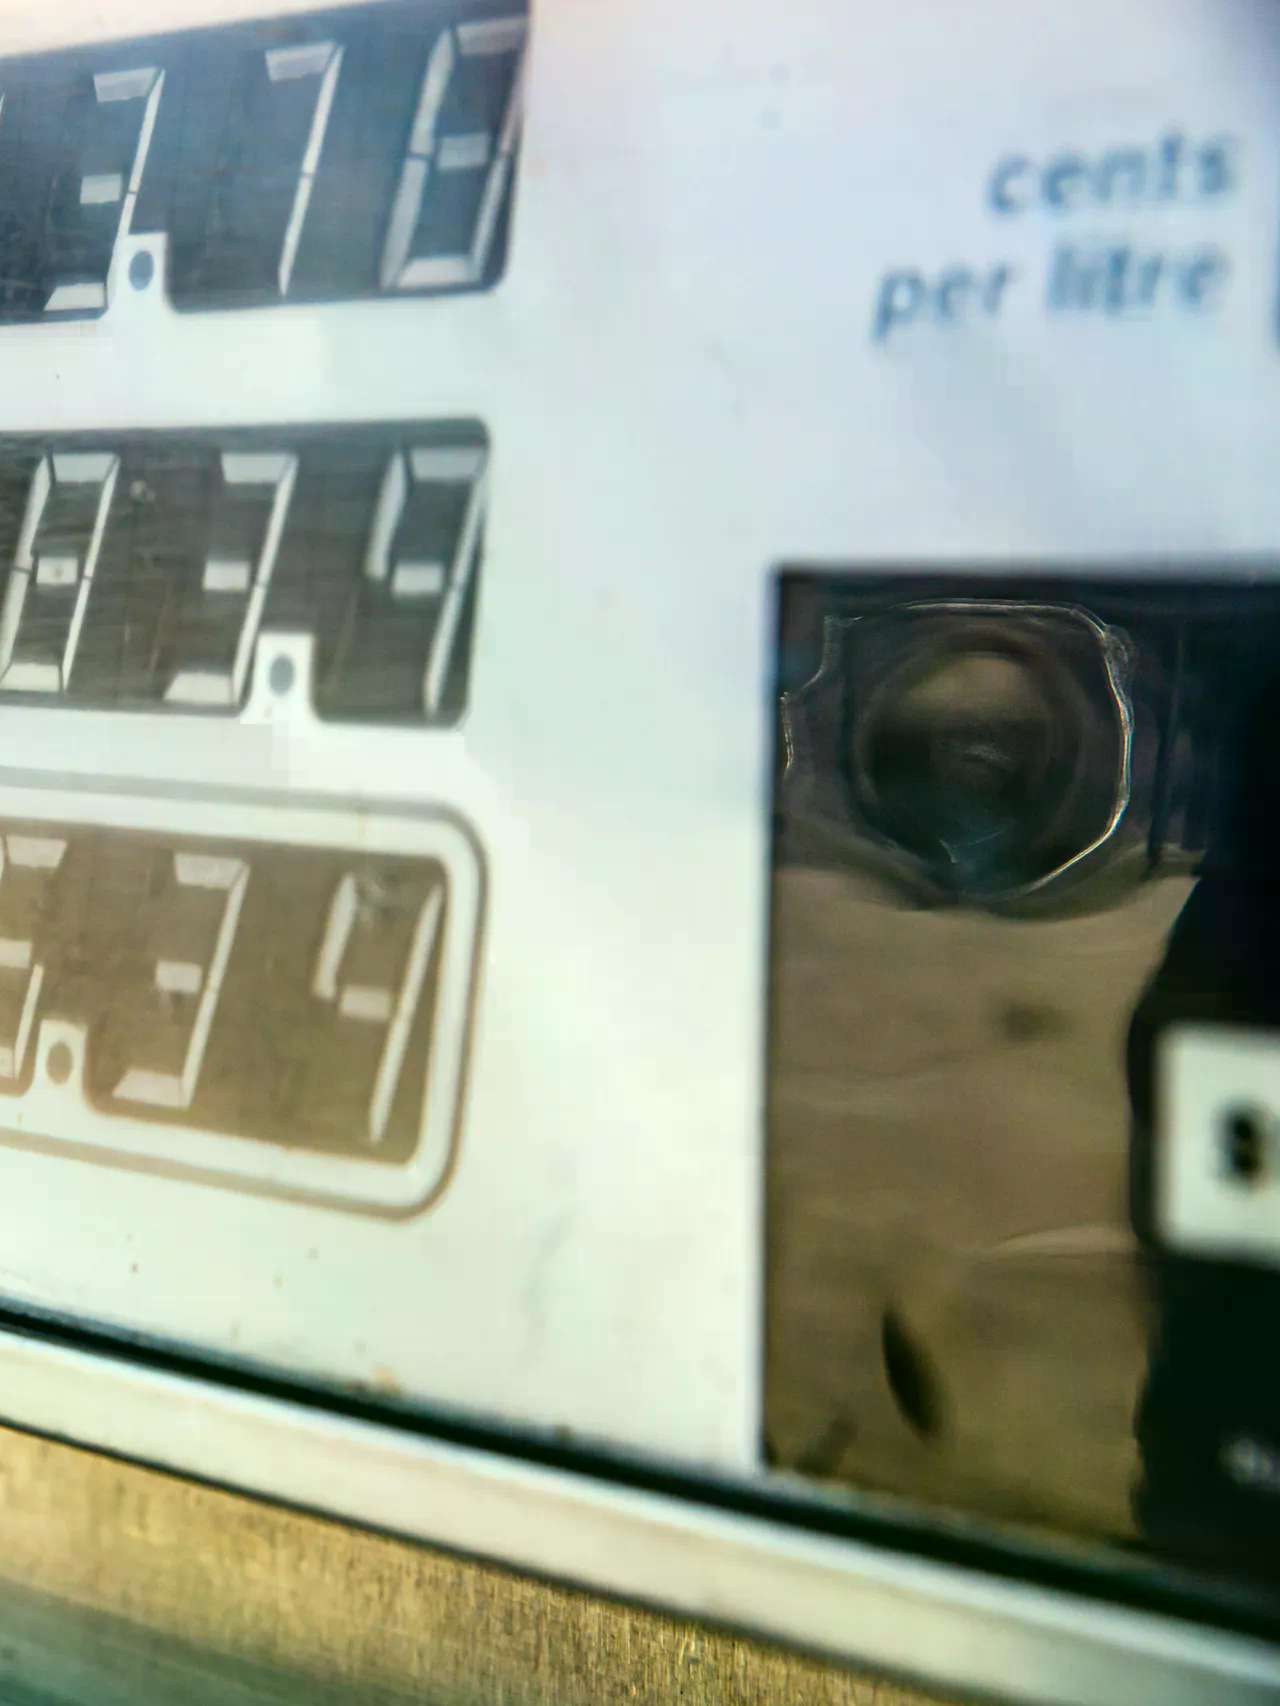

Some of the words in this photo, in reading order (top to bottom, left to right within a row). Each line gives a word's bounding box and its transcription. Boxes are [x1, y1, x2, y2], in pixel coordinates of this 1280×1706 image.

[988, 128, 1236, 213] cents
[872, 263, 1012, 344] per
[1048, 243, 1228, 316] litre
